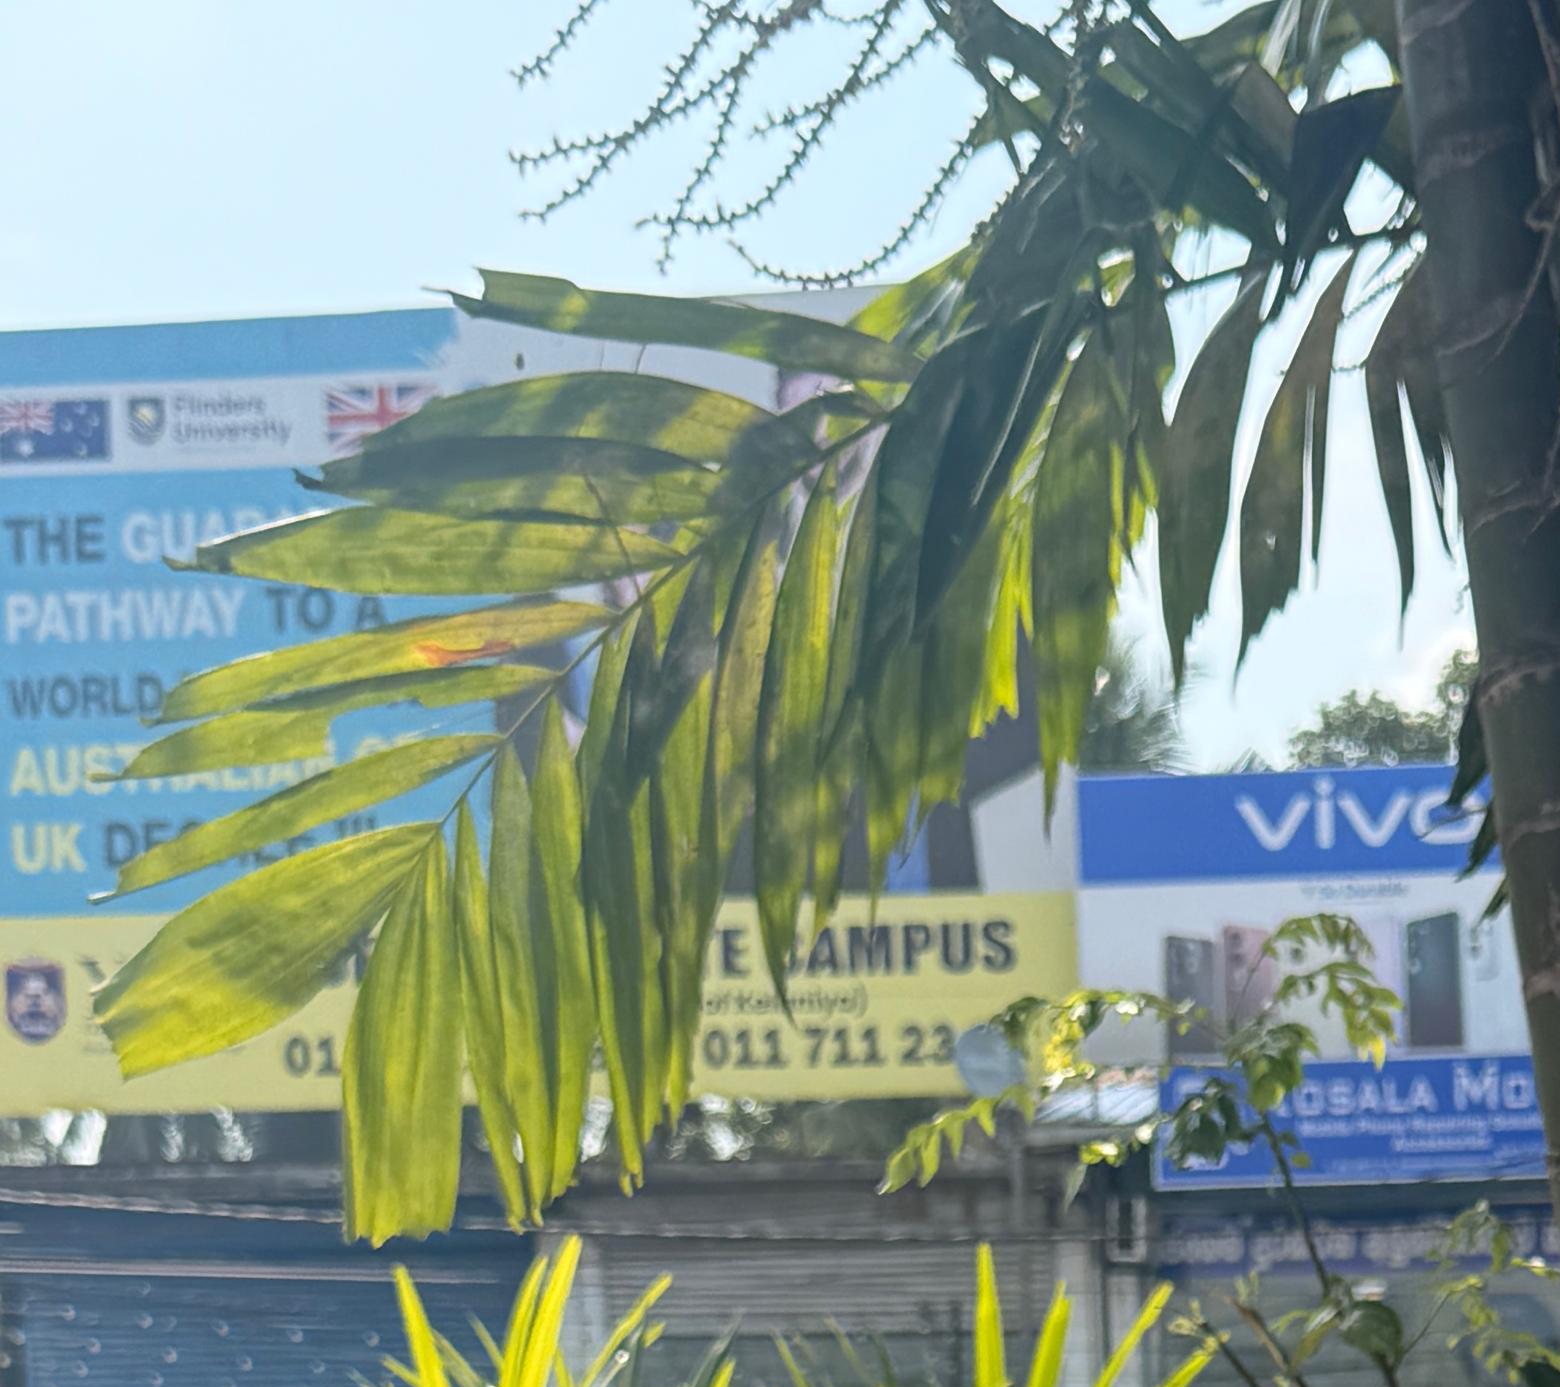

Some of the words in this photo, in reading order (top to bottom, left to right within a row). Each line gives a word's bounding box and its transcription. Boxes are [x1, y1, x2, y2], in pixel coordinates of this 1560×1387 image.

[3, 514, 105, 566] THE
[4, 586, 247, 644] PATHWAY
[265, 587, 336, 633] TO
[11, 821, 87, 874] UK
[788, 920, 1018, 977] AMPUS
[283, 1036, 341, 1079] 01
[703, 1027, 788, 1070] 011
[803, 1026, 886, 1069] 711
[899, 1023, 957, 1066] 23
[1277, 1073, 1438, 1118] OSALA
